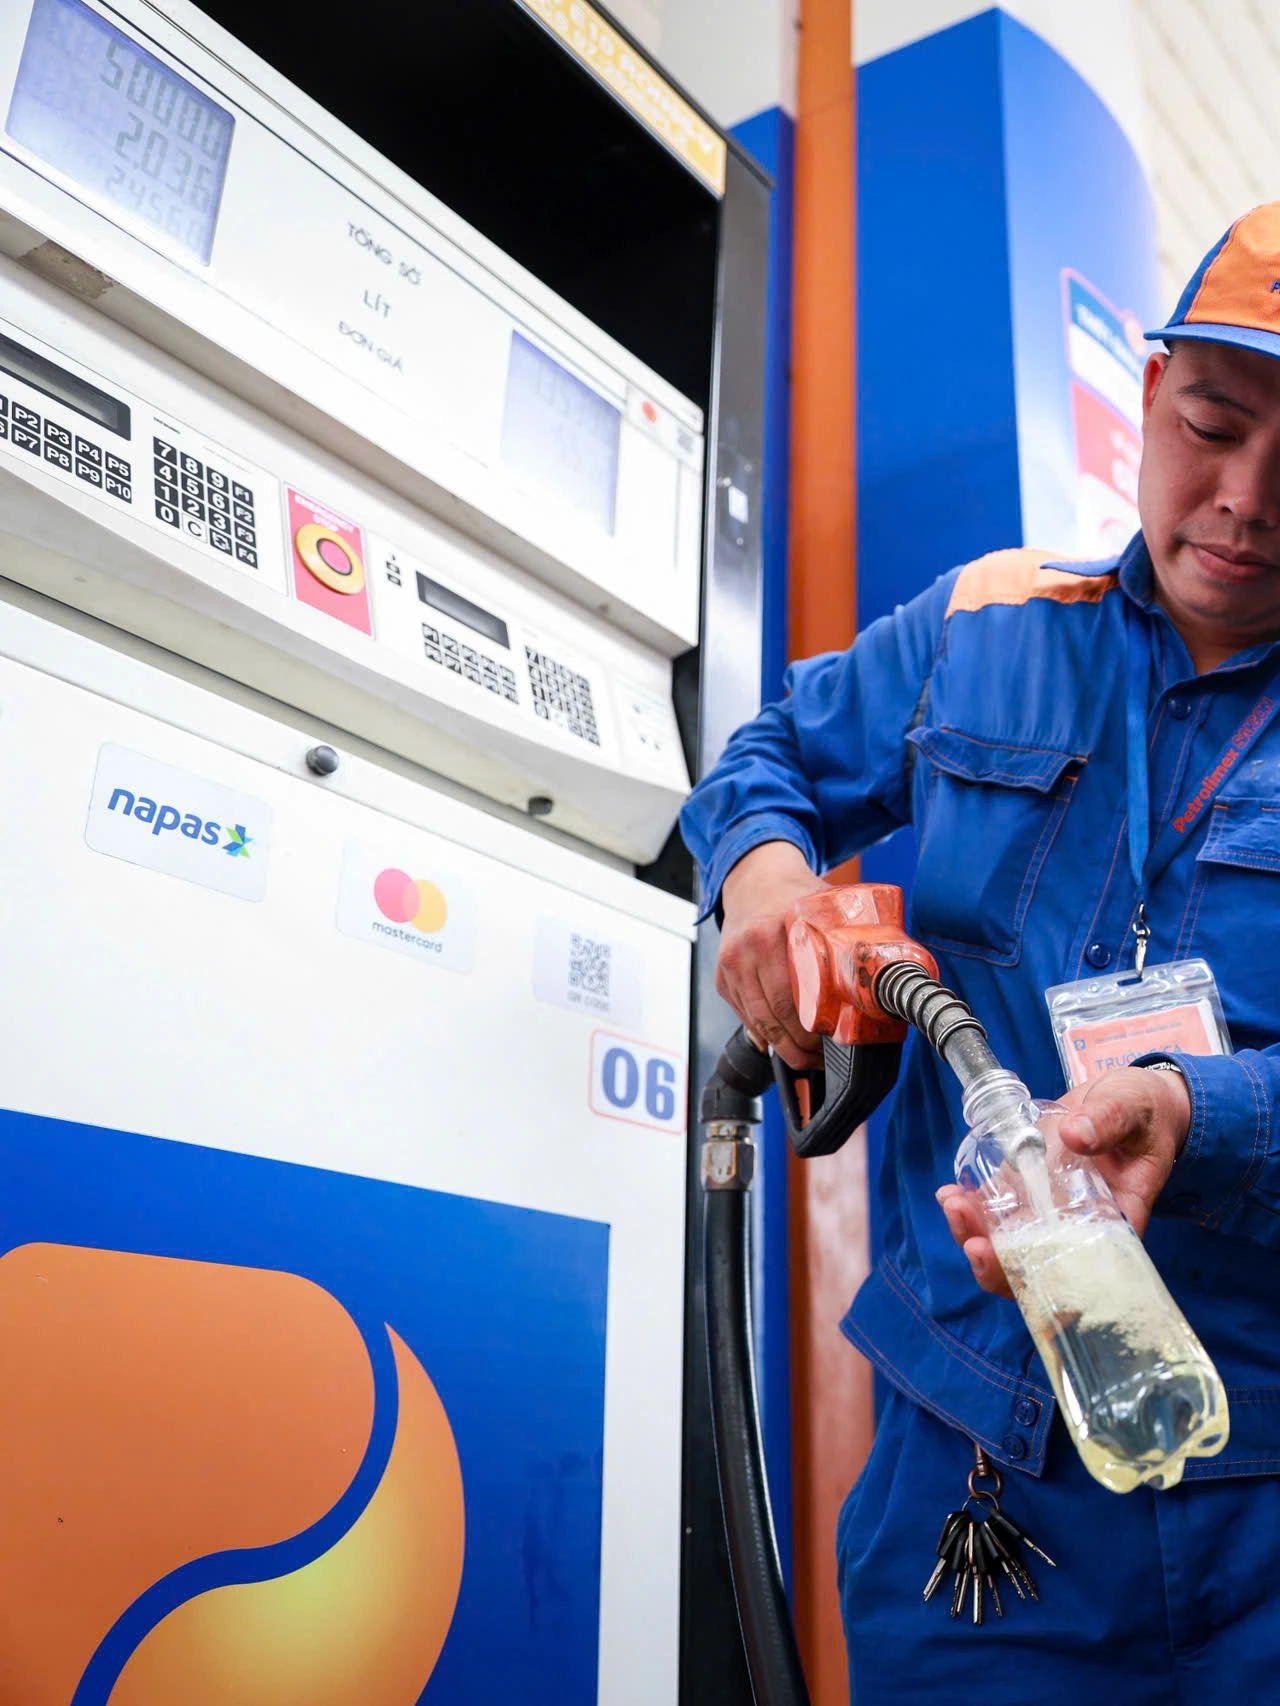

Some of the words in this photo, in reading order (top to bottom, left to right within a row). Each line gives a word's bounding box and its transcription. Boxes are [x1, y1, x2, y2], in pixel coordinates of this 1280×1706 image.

[14, 431, 38, 449] P7
[47, 447, 69, 467] P8
[79, 463, 100, 482] P9
[106, 479, 131, 499] P10
[15, 407, 38, 429] P2
[47, 424, 69, 445] P3
[79, 441, 100, 461] P4
[108, 457, 129, 477] P5
[158, 441, 171, 458] 7
[185, 458, 198, 475] 8
[211, 471, 224, 488] 9
[235, 486, 249, 502] F1
[159, 465, 172, 481] 4
[186, 479, 199, 495] 5
[212, 493, 225, 509] 6
[236, 507, 253, 523] F2
[161, 485, 170, 501] 1
[187, 499, 200, 517] 2
[213, 513, 226, 530] 3
[237, 527, 254, 543] F3
[160, 505, 174, 523] 0
[188, 521, 202, 537] C
[238, 548, 255, 563] F4
[107, 788, 221, 845] napas
[1173, 748, 1239, 833] Petrolimex
[372, 922, 443, 952] mastercard
[602, 1047, 676, 1121] 06
